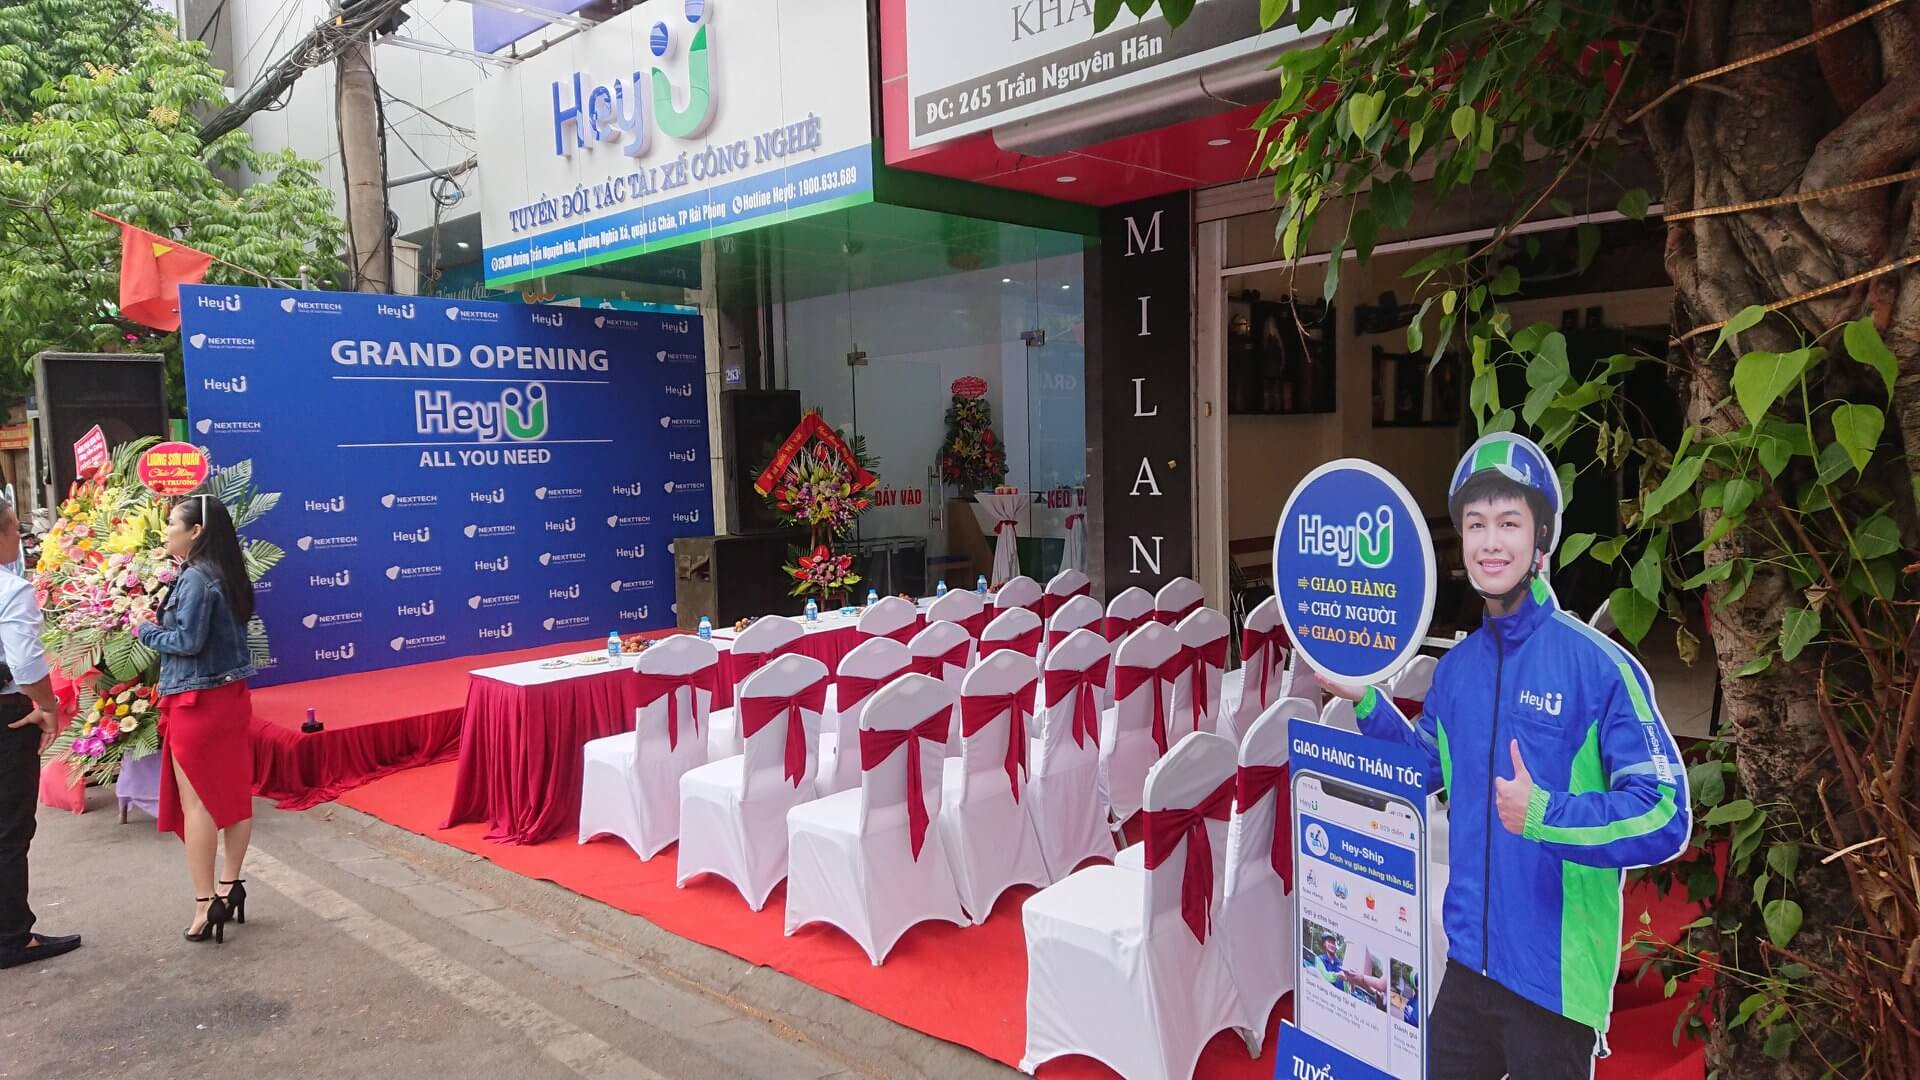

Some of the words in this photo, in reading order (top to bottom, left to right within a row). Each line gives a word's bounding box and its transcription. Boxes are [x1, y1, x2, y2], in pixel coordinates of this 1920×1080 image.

[926, 98, 954, 125] ĐC:
[959, 85, 991, 113] 265
[997, 73, 1036, 103] Trần
[1041, 50, 1115, 89] Nguyên
[1121, 34, 1162, 65] Hãn
[594, 176, 625, 209] TÁC
[691, 142, 750, 181] CÔNG
[753, 112, 822, 164] NGHỆ
[742, 190, 771, 211] Hotline
[772, 183, 797, 204] HeyU:
[799, 166, 857, 197] 1900.633.689
[679, 210, 688, 226] TP
[198, 294, 241, 311] HeyU
[298, 302, 342, 311] NEXTTECH
[378, 303, 415, 319] HeyU
[460, 310, 498, 319] NEXTTECH
[532, 313, 563, 327] HeyU
[661, 320, 688, 334] HeyU
[208, 337, 255, 345] NEXTTECH
[331, 340, 461, 369] GRAND
[469, 344, 609, 371] OPENING
[204, 376, 247, 393] HeyU
[665, 383, 692, 397] HeyU
[414, 382, 548, 442] HeyU
[214, 421, 261, 430] NEXTTECH
[420, 450, 456, 467] ALL
[459, 450, 498, 466] YOU
[503, 449, 550, 464] NEED
[669, 449, 695, 462] HeyU
[470, 488, 504, 504] HeyU
[612, 482, 641, 496] HeyU
[901, 486, 922, 506] VÀO
[305, 496, 345, 512] HeyU
[397, 495, 437, 504] NEXTTECH
[1047, 486, 1071, 509] KÉO
[673, 509, 699, 523] HeyU
[478, 525, 515, 534] NEXTTECH
[545, 517, 576, 532] HeyU
[314, 535, 357, 545] NEXTTECH
[393, 527, 430, 543] HeyU
[1298, 504, 1394, 569] HeyU
[552, 552, 586, 561] NEXTTECH
[616, 544, 645, 558] HeyU
[401, 565, 441, 575] NEXTTECH
[475, 555, 509, 572] HeyU
[310, 569, 350, 587] HeyU
[622, 580, 654, 588] NEXTTECH
[549, 583, 580, 599] HeyU
[1310, 576, 1347, 594] GIAO
[1351, 577, 1397, 598] HÀNG
[482, 594, 520, 604] NEXTTECH
[398, 600, 434, 617] HeyU
[619, 605, 648, 620] HeyU
[1311, 599, 1341, 619] CHỞ
[1345, 604, 1397, 625] NGƯỜI
[319, 611, 362, 623] NEXTTECH
[556, 616, 590, 625] NEXTTECH
[479, 622, 513, 639] HeyU
[1311, 624, 1347, 643] GIAO
[406, 634, 446, 646] NEXTTECH
[315, 642, 354, 661] HeyU
[1520, 689, 1563, 717] HeyU
[1293, 738, 1319, 758] GIAO
[1322, 746, 1355, 769] HÀNG
[1396, 766, 1423, 788] TỐC
[1341, 839, 1385, 866] Hey-Ship
[1353, 861, 1368, 874] giao
[1292, 1055, 1334, 1080] TUYỂ
